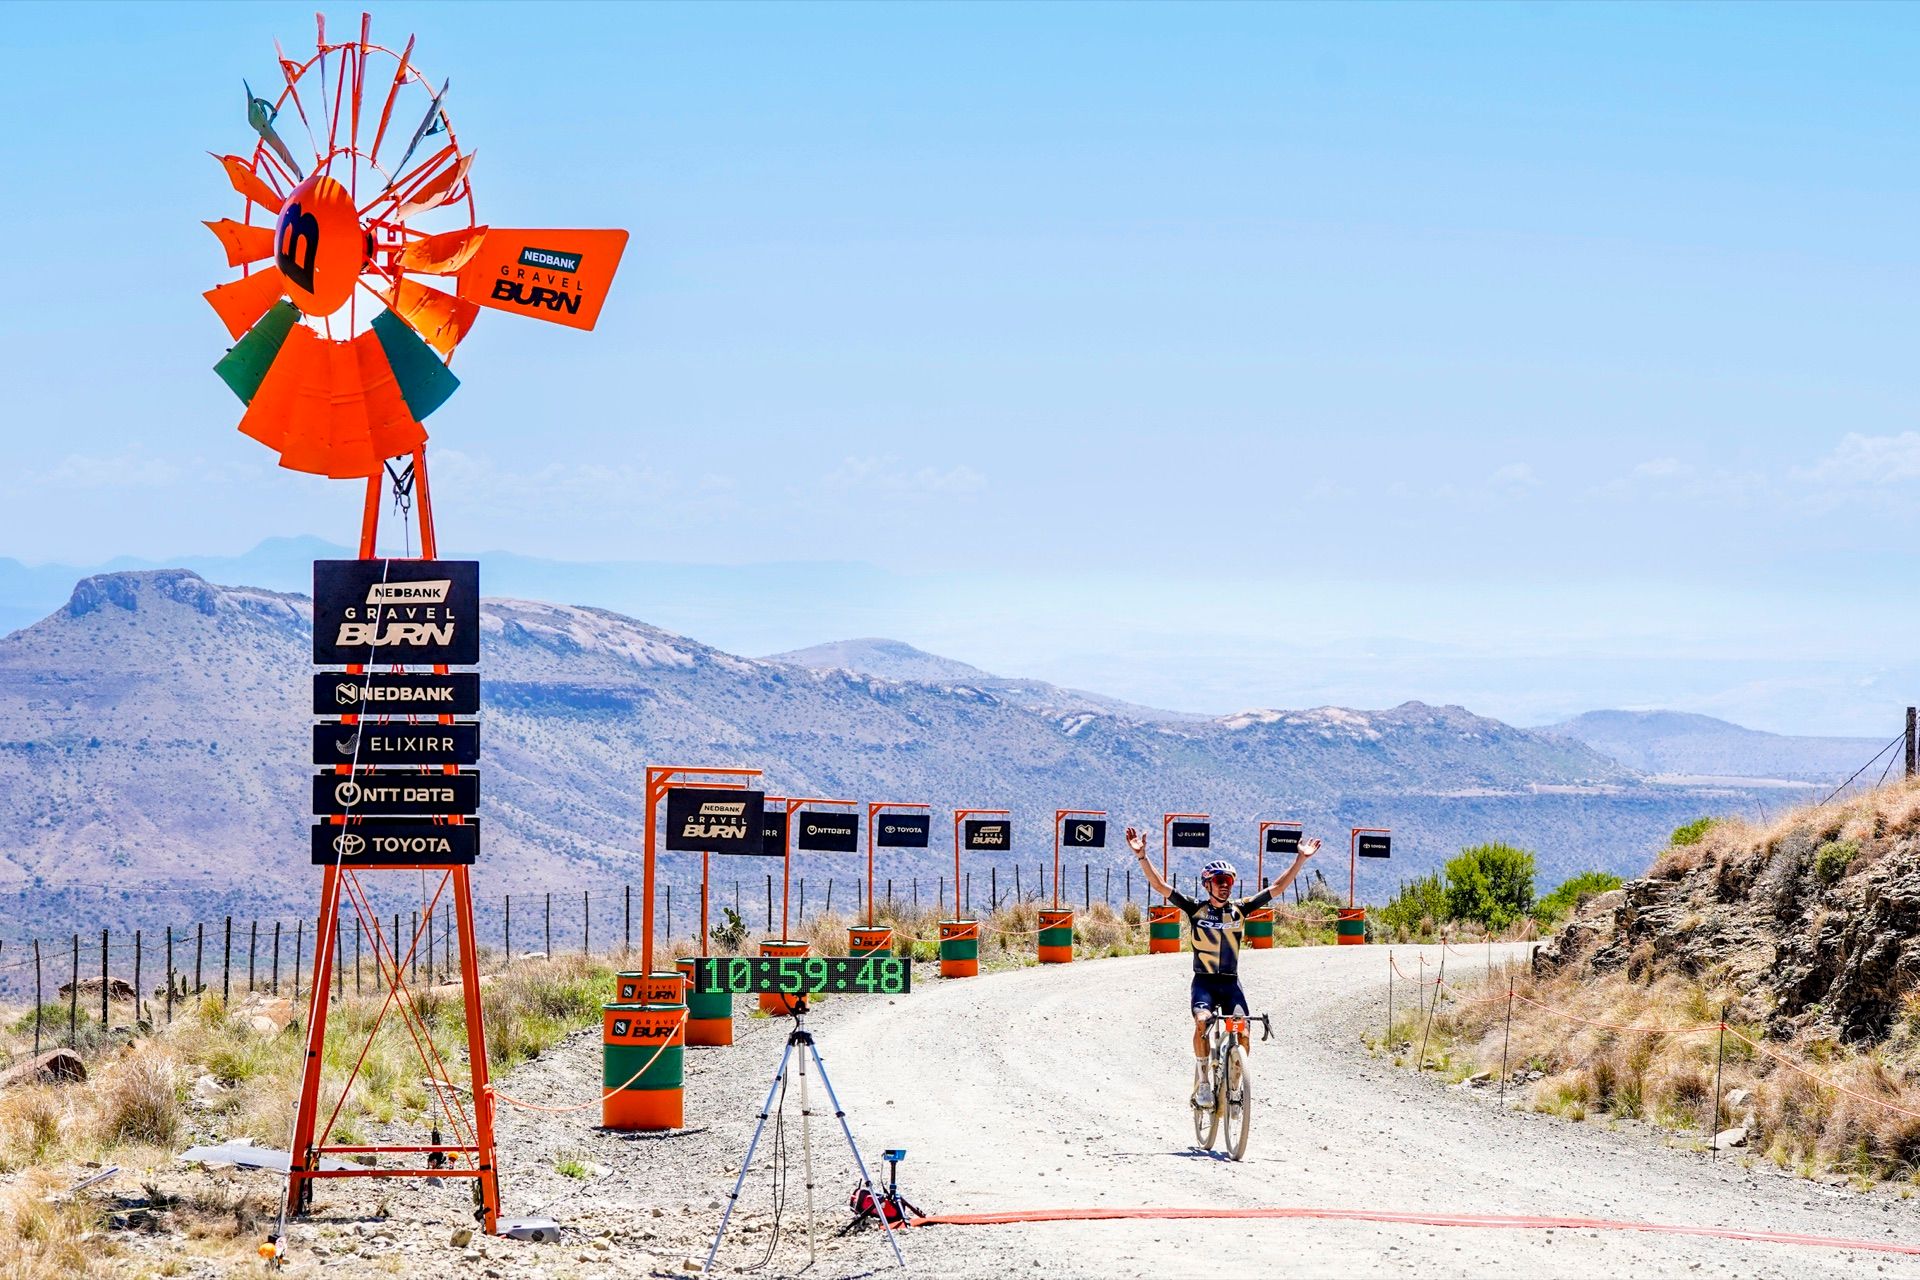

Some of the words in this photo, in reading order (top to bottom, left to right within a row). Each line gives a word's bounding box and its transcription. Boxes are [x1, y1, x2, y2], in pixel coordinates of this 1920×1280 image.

[523, 248, 577, 270] NEDBANK
[500, 264, 584, 292] GRAVEL
[490, 279, 582, 315] BURN
[374, 587, 441, 598] NEDBANK
[344, 606, 455, 620] GRAVEL
[335, 622, 454, 647] BURN
[359, 686, 453, 702] NEDBANK
[370, 737, 454, 752] ELIXIRR
[363, 787, 401, 803] NTT
[703, 804, 741, 813] NEDBANK
[687, 815, 748, 825] GRAVEL
[682, 824, 747, 839] BURN
[896, 826, 922, 834] TOYOTA
[372, 837, 452, 853] TOYOTA
[705, 957, 903, 994] 10:59:48
